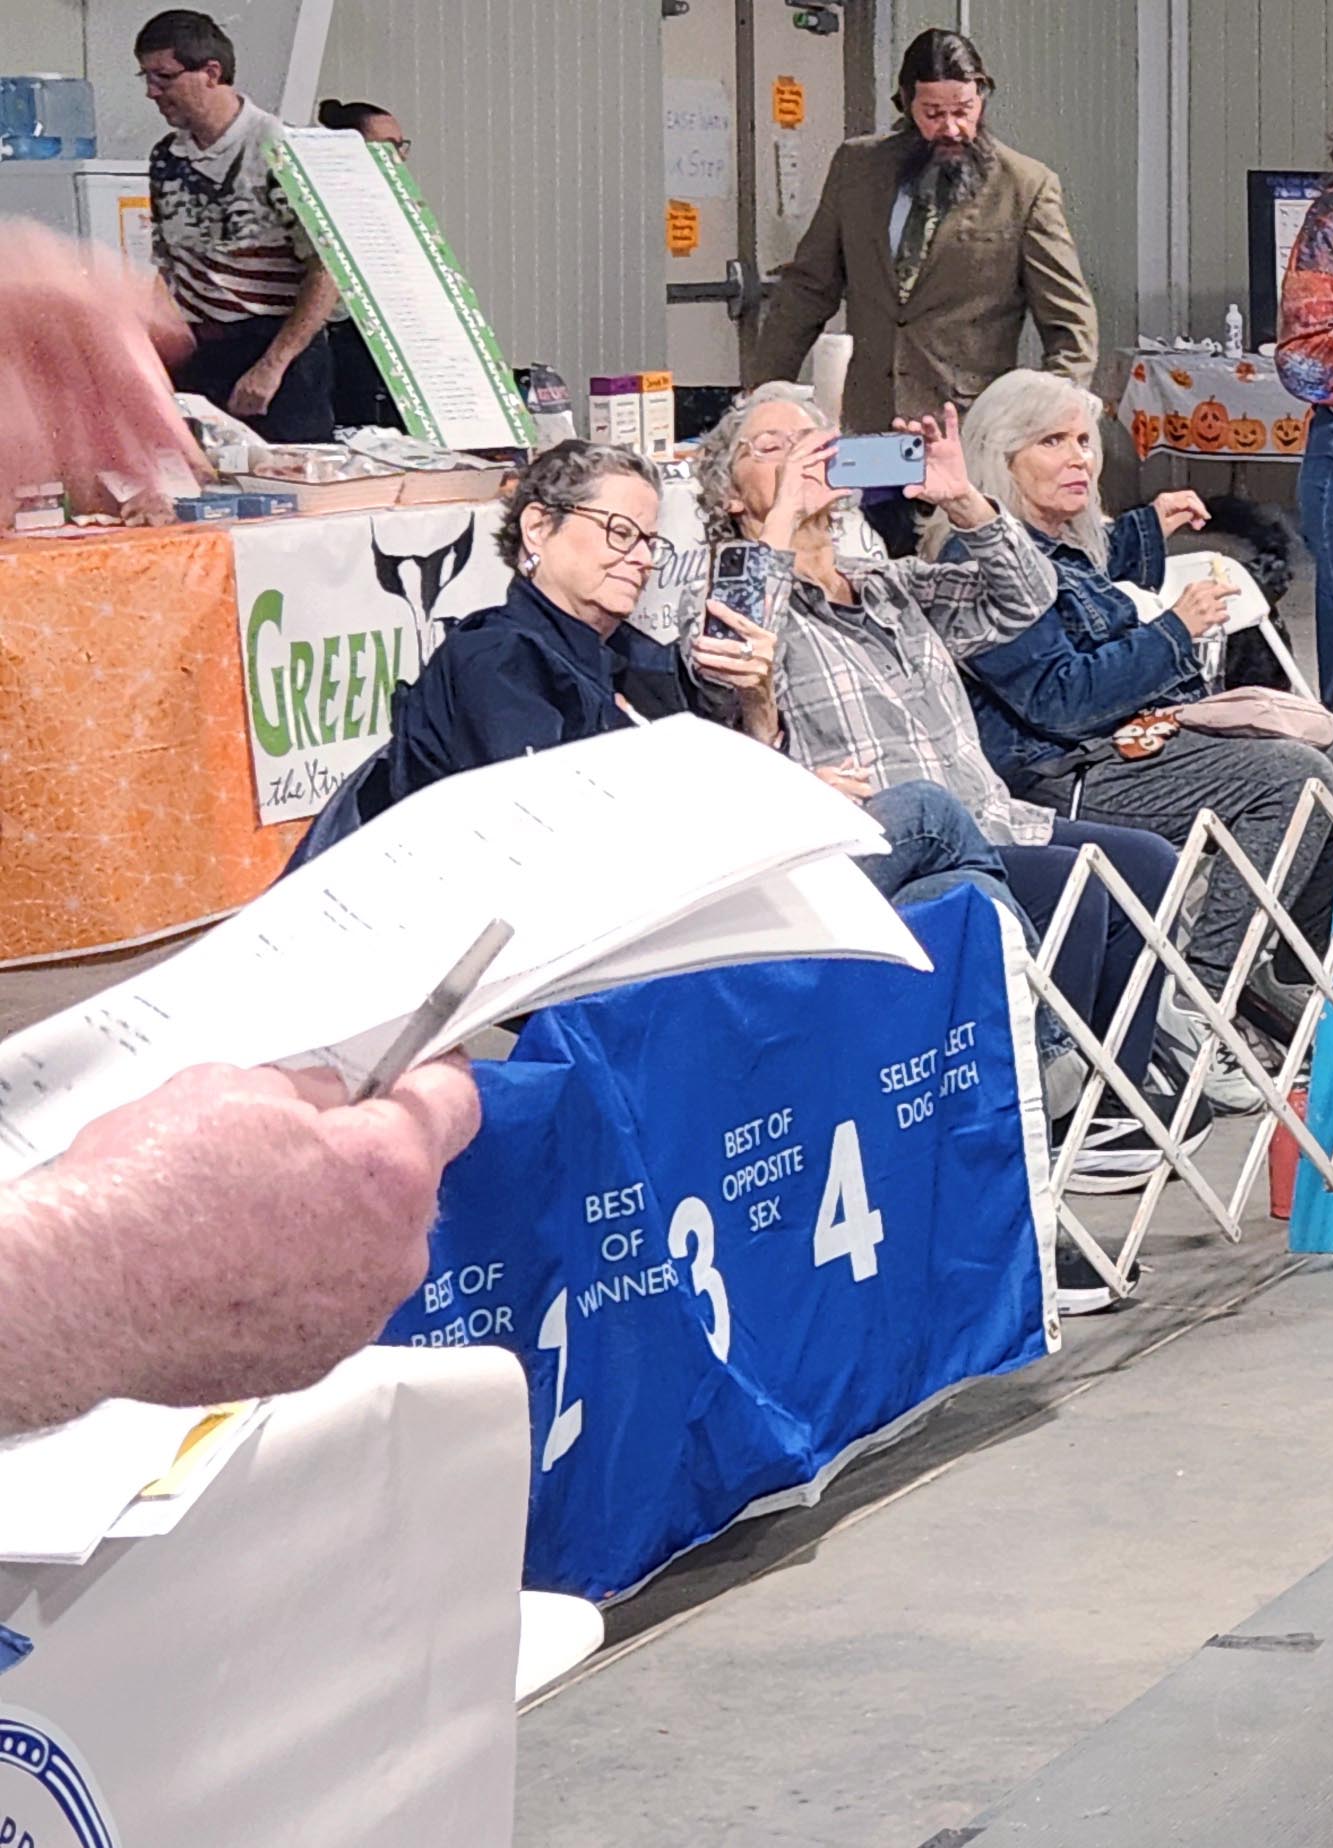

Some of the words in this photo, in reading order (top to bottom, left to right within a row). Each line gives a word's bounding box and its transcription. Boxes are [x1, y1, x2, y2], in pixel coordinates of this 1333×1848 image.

[667, 110, 696, 130] EASE
[247, 588, 404, 758] GREEN
[944, 1021, 976, 1057] LECT
[879, 1048, 938, 1094] SELECT
[939, 1060, 980, 1098] ITCH
[896, 1091, 934, 1129] DOG
[723, 1117, 764, 1159] BEST
[767, 1107, 794, 1140] OF
[722, 1144, 805, 1202] OPPOSITE
[584, 1182, 645, 1224] BEST
[749, 1195, 782, 1233] SEX
[813, 1119, 884, 1283] 4
[601, 1228, 645, 1262] OF
[458, 1262, 505, 1295] OF
[667, 1196, 731, 1365] 3
[468, 1305, 515, 1338] OR
